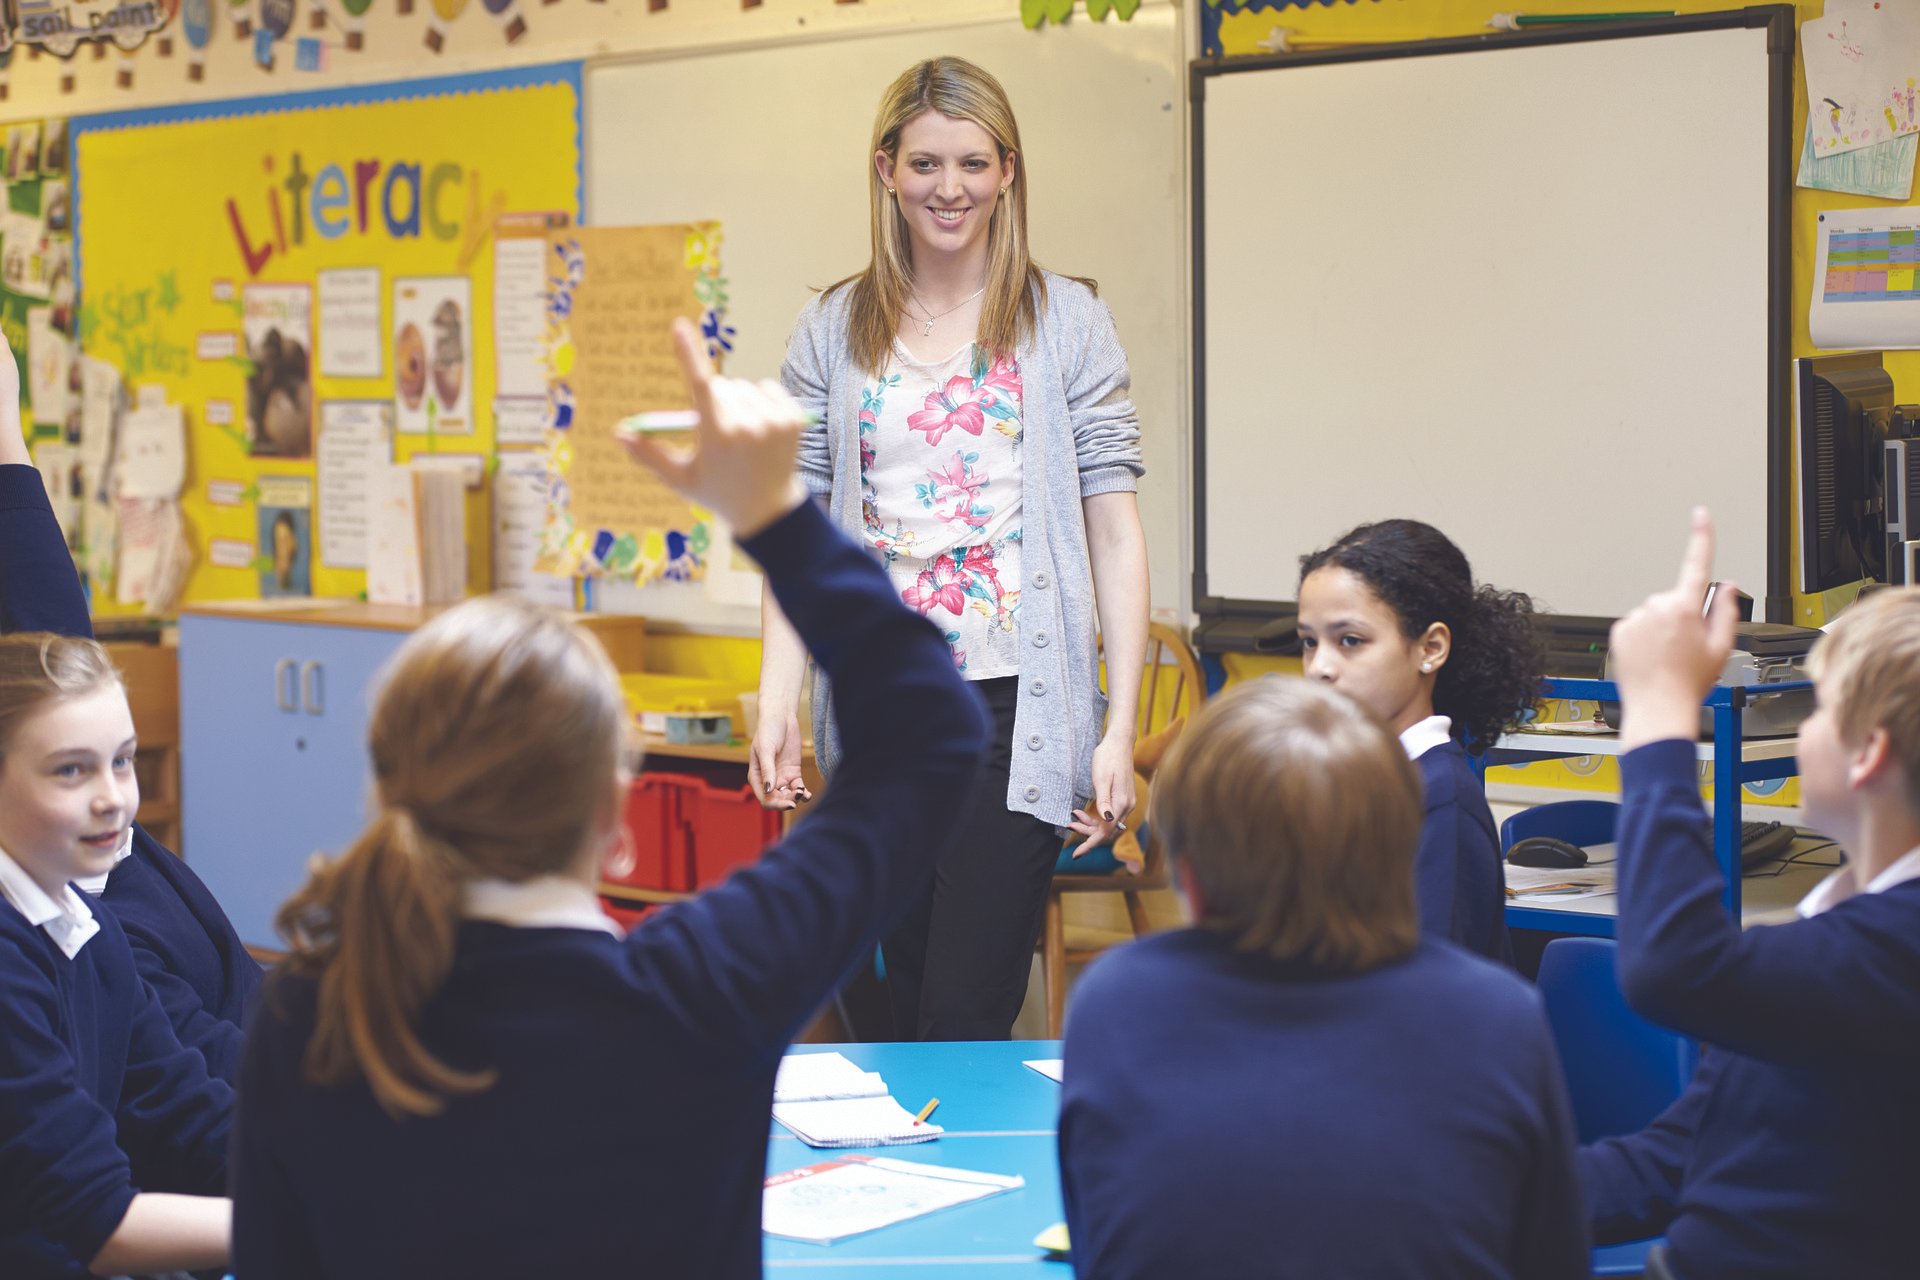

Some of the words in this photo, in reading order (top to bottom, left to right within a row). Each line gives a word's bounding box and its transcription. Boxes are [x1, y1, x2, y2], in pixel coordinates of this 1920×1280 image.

[25, 5, 72, 37] sail
[90, 2, 155, 33] paint
[225, 152, 507, 278] Literacy
